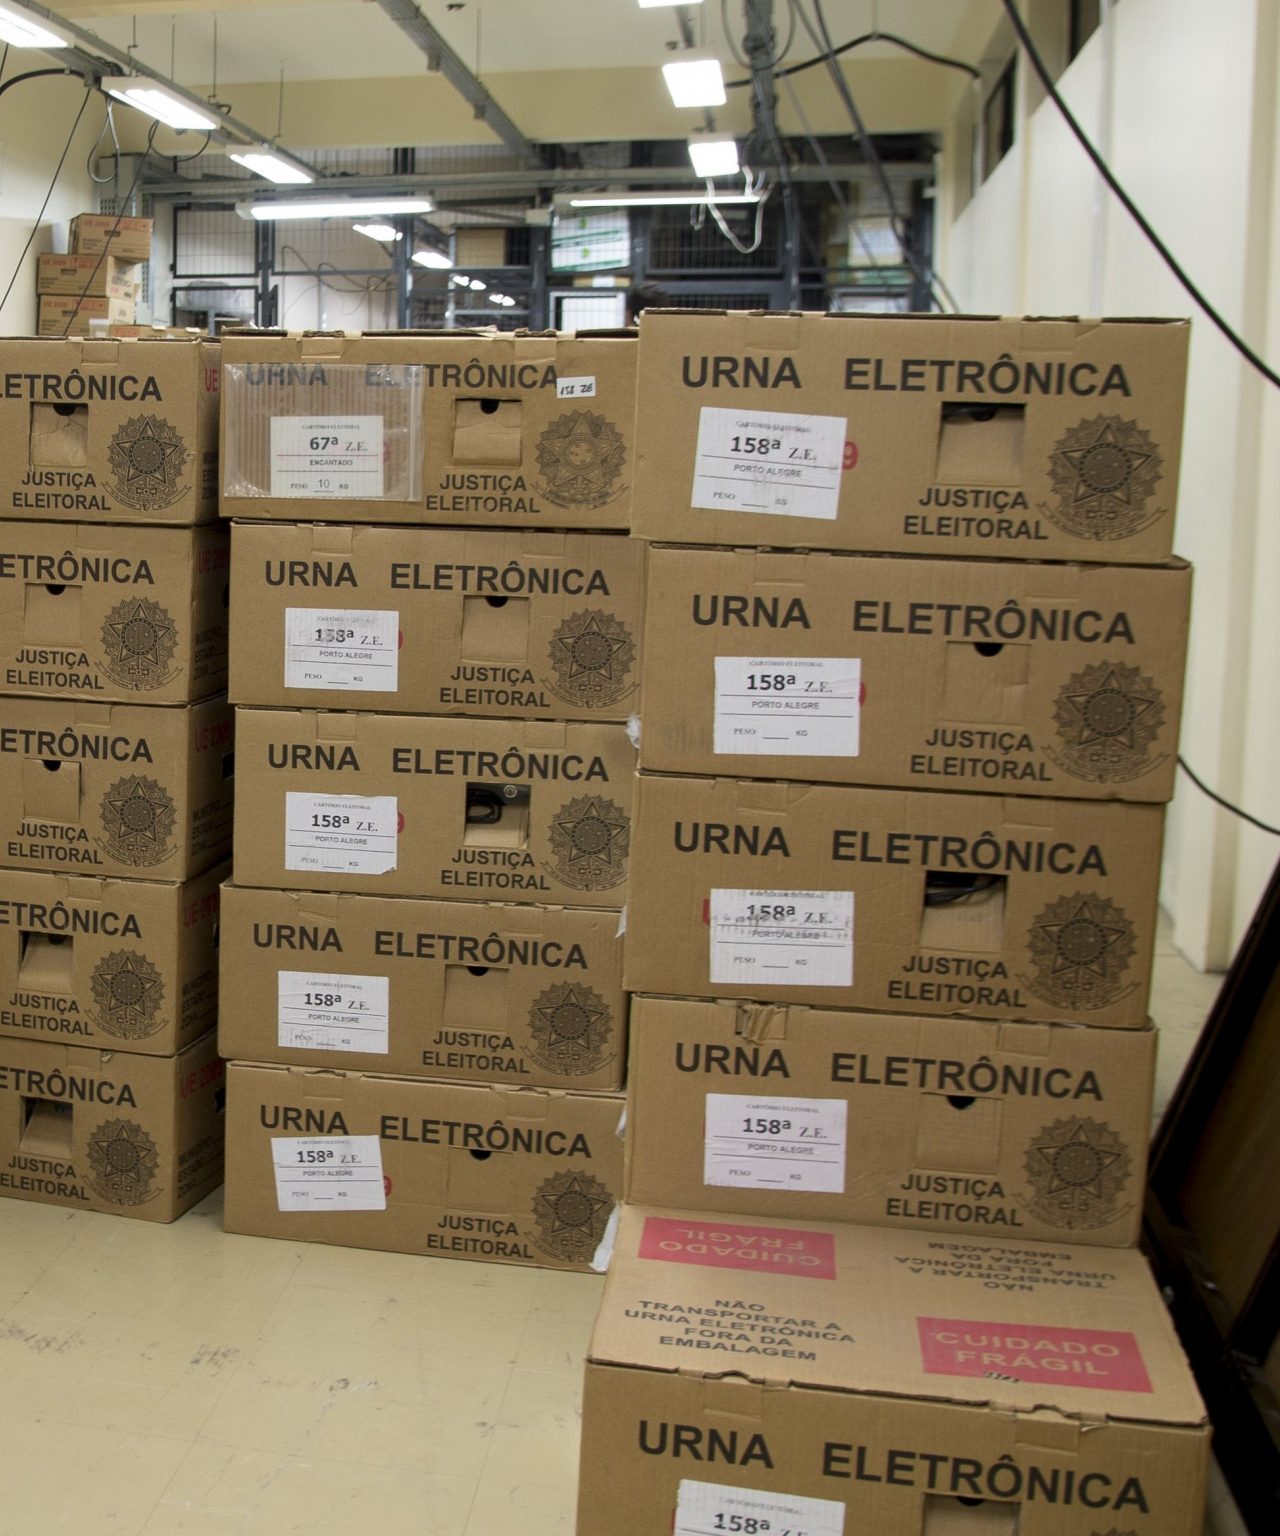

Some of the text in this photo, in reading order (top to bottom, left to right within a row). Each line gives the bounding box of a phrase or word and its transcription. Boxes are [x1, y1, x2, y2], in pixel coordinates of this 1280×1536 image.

[246, 363, 328, 386] URNA
[682, 353, 1132, 397] URNA ELETRÔNICA
[310, 437, 338, 450] 67ª
[731, 436, 781, 454] 158ª
[22, 472, 96, 490] JUSTIÇA
[734, 464, 802, 478] PORTO ALEGRE
[440, 475, 527, 496] JUSTIÇA
[13, 493, 111, 510] ELEITORAL
[426, 495, 540, 513] ELEITORAL
[918, 488, 1028, 514] JUSTIÇA
[904, 515, 1048, 540] ELEITORAL
[265, 561, 610, 596] URNA ELETRÔNICA
[692, 594, 1135, 644] URNA ELETRÔNICA
[16, 650, 89, 669] JUSTIÇA
[7, 670, 104, 690] ELEITORAL
[451, 667, 535, 687] JUSTIÇA
[747, 674, 796, 691] 158ª
[440, 688, 550, 707] ELEITORAL
[925, 729, 1034, 755] JUSTIÇA
[269, 743, 609, 782] URNA ELETRÔNICA
[910, 755, 1053, 782] ELEITORAL
[312, 814, 349, 828] 158ª
[17, 823, 89, 844] JUSTIÇA
[8, 842, 103, 864] ELEITORAL
[452, 849, 535, 870] JUSTIÇA
[674, 822, 1108, 877] URNA ELETRÔNICA
[441, 870, 551, 890] ELEITORAL
[254, 923, 588, 969] URNA ELETRÔNICA
[903, 956, 1009, 982] JUSTIÇA
[10, 993, 80, 1015] JUSTIÇA
[305, 993, 341, 1006] 158ª
[888, 980, 1027, 1009] ELEITORAL
[1, 1012, 94, 1036] ELEITORAL
[433, 1031, 514, 1052] JUSTIÇA
[422, 1051, 530, 1073] ELEITORAL
[676, 1043, 1103, 1101] URNA ELETRÔNICA
[260, 1105, 591, 1158] URNA ELETRÔNICA
[743, 1118, 791, 1134] 158ª
[748, 1143, 814, 1154] PORTO ALEGRE
[8, 1156, 76, 1178] JUSTIÇA
[0, 1173, 90, 1200] ELEITORAL
[900, 1174, 1004, 1200] JUSTIÇA
[886, 1198, 1024, 1227] ELEITORAL
[438, 1215, 518, 1237] JUSTIÇA
[427, 1234, 534, 1259] ELEITORAL
[677, 1229, 804, 1250] FRÁGIL
[659, 1241, 820, 1266] CUIDADO
[639, 1301, 842, 1330] TRANSPORTAR A
[715, 1300, 765, 1312] NÃO
[624, 1310, 856, 1343] URNA ELETRÔNICA
[684, 1327, 792, 1346] FORA DA
[659, 1336, 816, 1360] EMBALAGEM
[933, 1332, 1119, 1357] CUIDADO
[956, 1350, 1109, 1376] FRÁGIL
[638, 1420, 1149, 1514] URNA ELETRÔNICA
